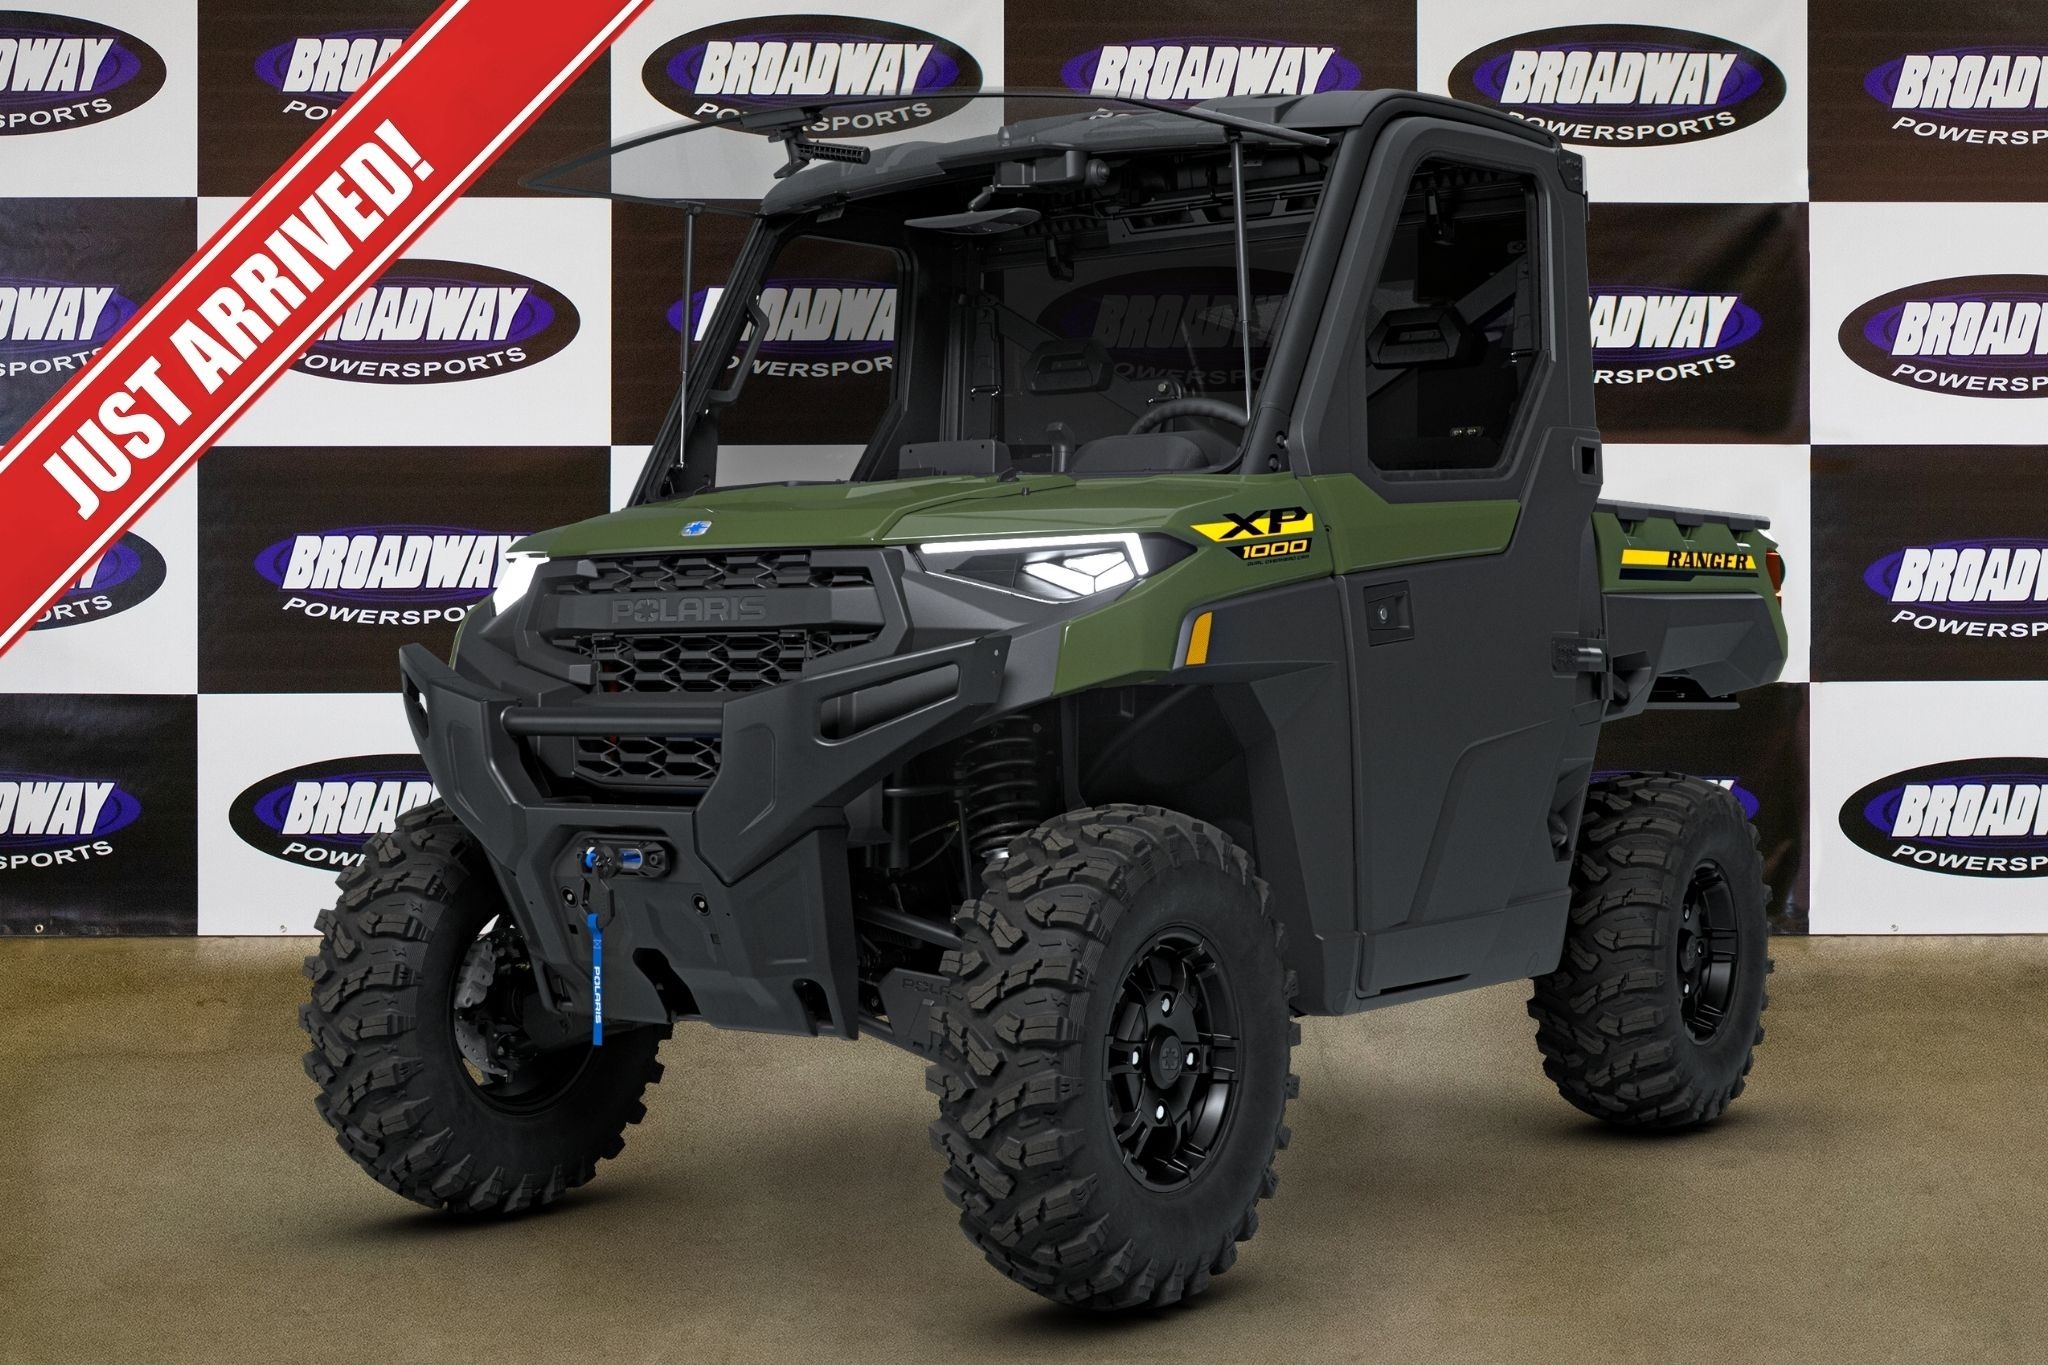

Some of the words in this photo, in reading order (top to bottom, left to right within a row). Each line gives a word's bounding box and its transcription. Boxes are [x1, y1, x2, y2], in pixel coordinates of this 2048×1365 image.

[694, 41, 934, 96] BROADWAY
[1090, 46, 1335, 100] BROADWAY
[1500, 50, 1738, 105] BROADWAY
[1891, 55, 2048, 109] BROAD
[0, 98, 113, 128] PORTS
[317, 286, 529, 341] OADWAY
[1891, 301, 2048, 356] BROAD
[298, 347, 527, 378] OWERSPORTS
[1218, 506, 1309, 540] XP
[1243, 539, 1308, 559] 1000
[1667, 550, 1748, 571] RANGER
[1891, 548, 2048, 602] BROAD
[282, 597, 476, 625] POWERSPO
[611, 596, 767, 624] POLARIS
[282, 781, 442, 835] BROAD
[1891, 784, 2048, 837] BROAD
[0, 840, 113, 870] PORTS
[593, 965, 603, 1025] POLARIS
